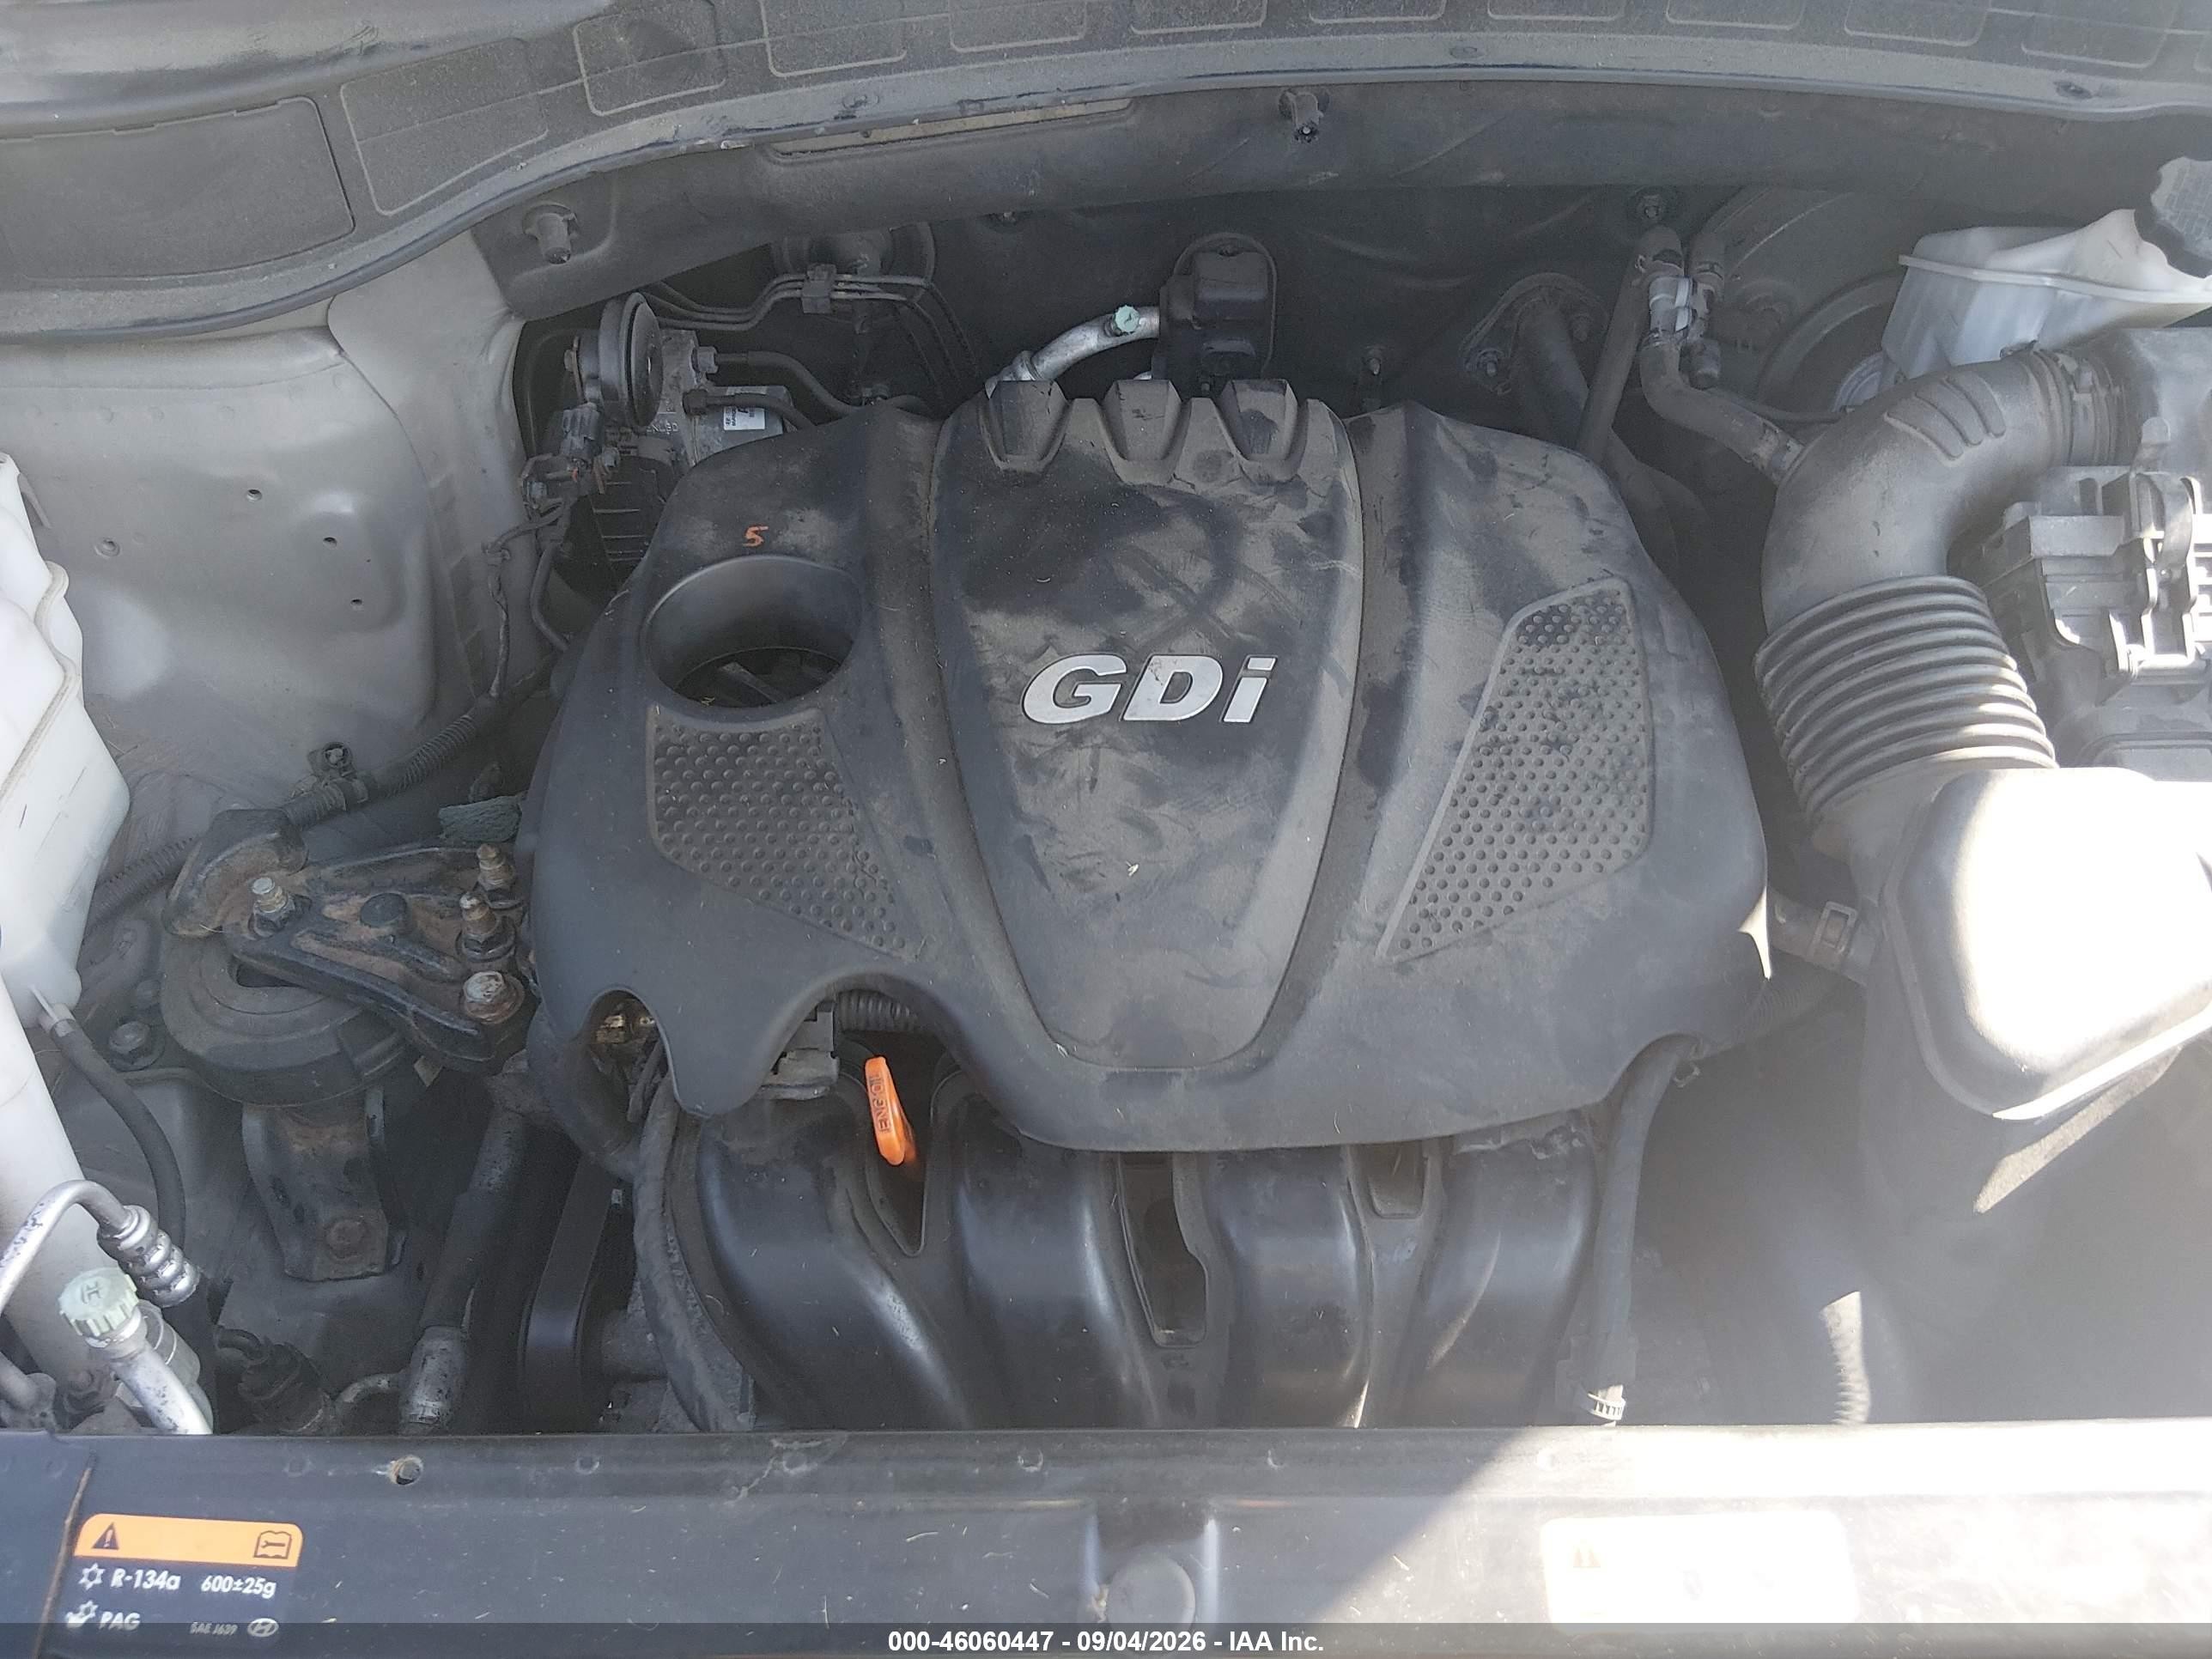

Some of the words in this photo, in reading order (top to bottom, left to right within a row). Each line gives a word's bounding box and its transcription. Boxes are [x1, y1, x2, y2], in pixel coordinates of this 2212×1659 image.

[742, 525, 769, 548] 5
[1022, 653, 1278, 724] GDi
[81, 1279, 103, 1305] H
[111, 1568, 181, 1590] R-134a
[201, 1575, 276, 1599] 600±25g
[98, 1610, 141, 1631] PAG
[190, 1621, 212, 1635] SAE
